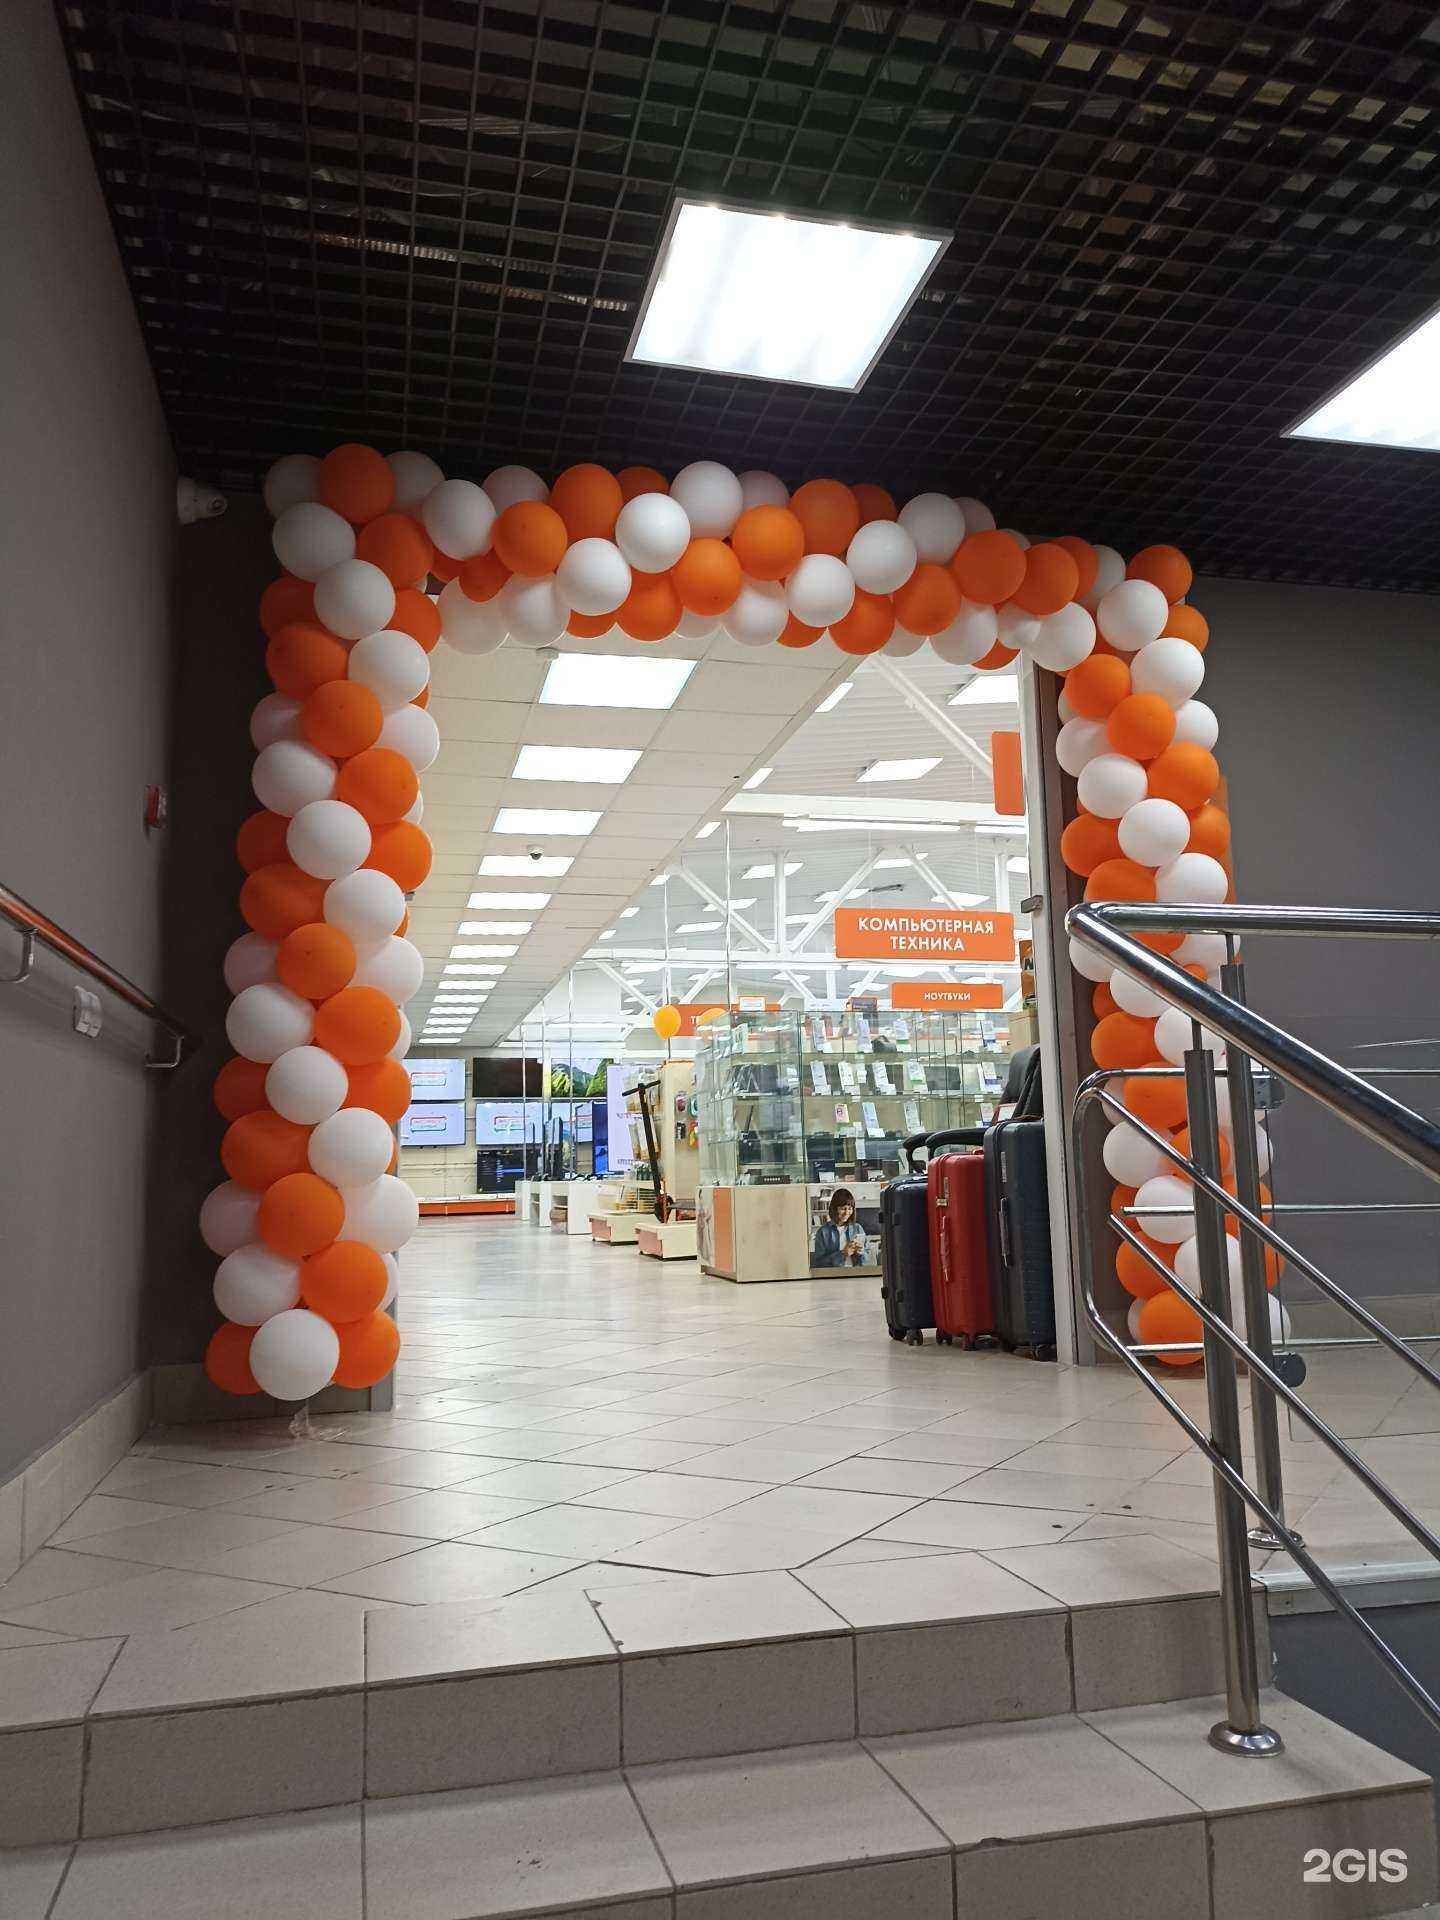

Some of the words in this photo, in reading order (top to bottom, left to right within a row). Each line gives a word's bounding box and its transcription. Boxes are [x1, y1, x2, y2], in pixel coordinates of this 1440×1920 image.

[858, 917, 994, 934] КОМПЬЮТЕРНАЯ
[890, 936, 965, 951] ТЕХНИКА
[924, 992, 971, 1001] НОУТБУКИ
